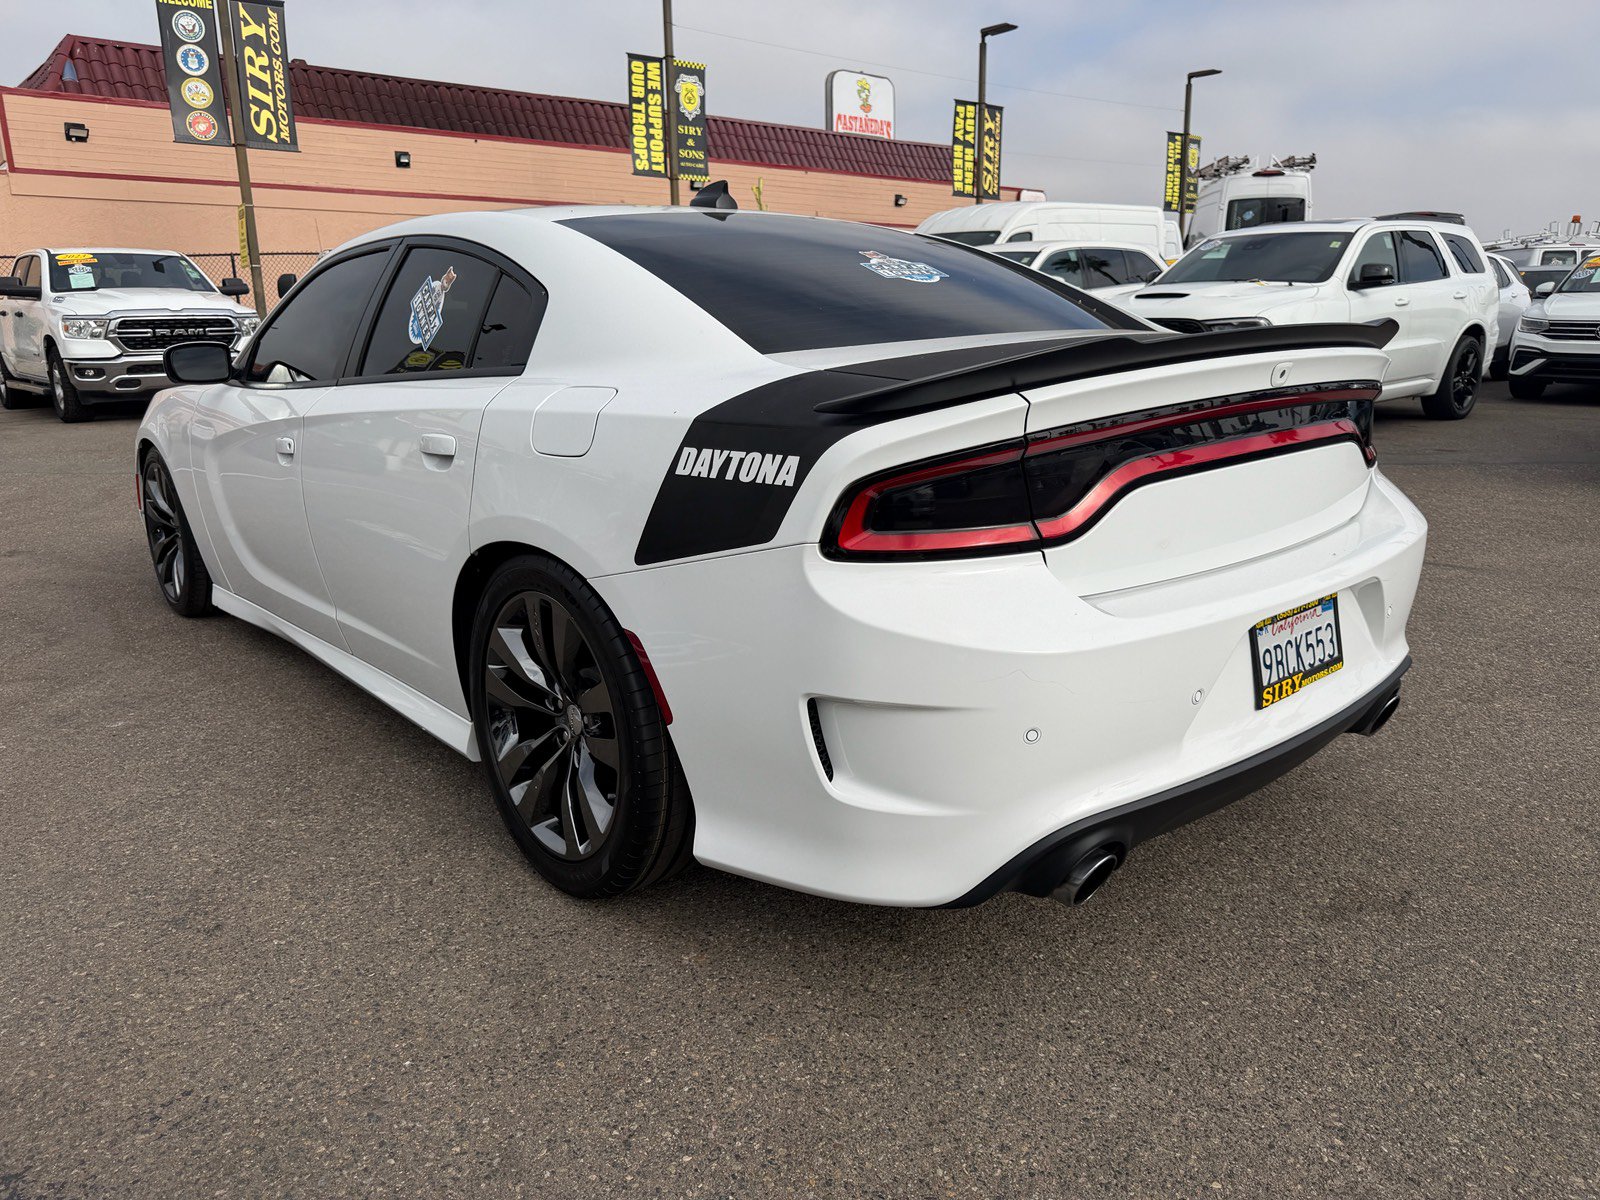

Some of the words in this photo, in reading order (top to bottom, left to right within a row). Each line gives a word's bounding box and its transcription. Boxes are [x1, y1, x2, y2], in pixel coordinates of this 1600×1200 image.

[238, 2, 278, 143] SIRY
[631, 61, 645, 98] OUR
[647, 62, 660, 91] WE
[632, 102, 648, 170] TROOPS
[648, 94, 664, 173] SUPPORT
[678, 125, 703, 136] SIRY
[686, 138, 695, 147] &
[954, 105, 965, 142] PAY
[965, 105, 975, 145] BUY
[678, 148, 704, 160] SONS
[953, 144, 963, 191] HERE
[964, 148, 974, 194] HERE
[982, 107, 995, 196] SIRY
[422, 285, 438, 334] CARFAX
[675, 446, 800, 487] DAYTONA
[1271, 608, 1322, 636] California
[1262, 622, 1335, 687] 9BCK553
[1262, 672, 1304, 708] SIRY
[1301, 661, 1343, 687] MOTORS.COM
